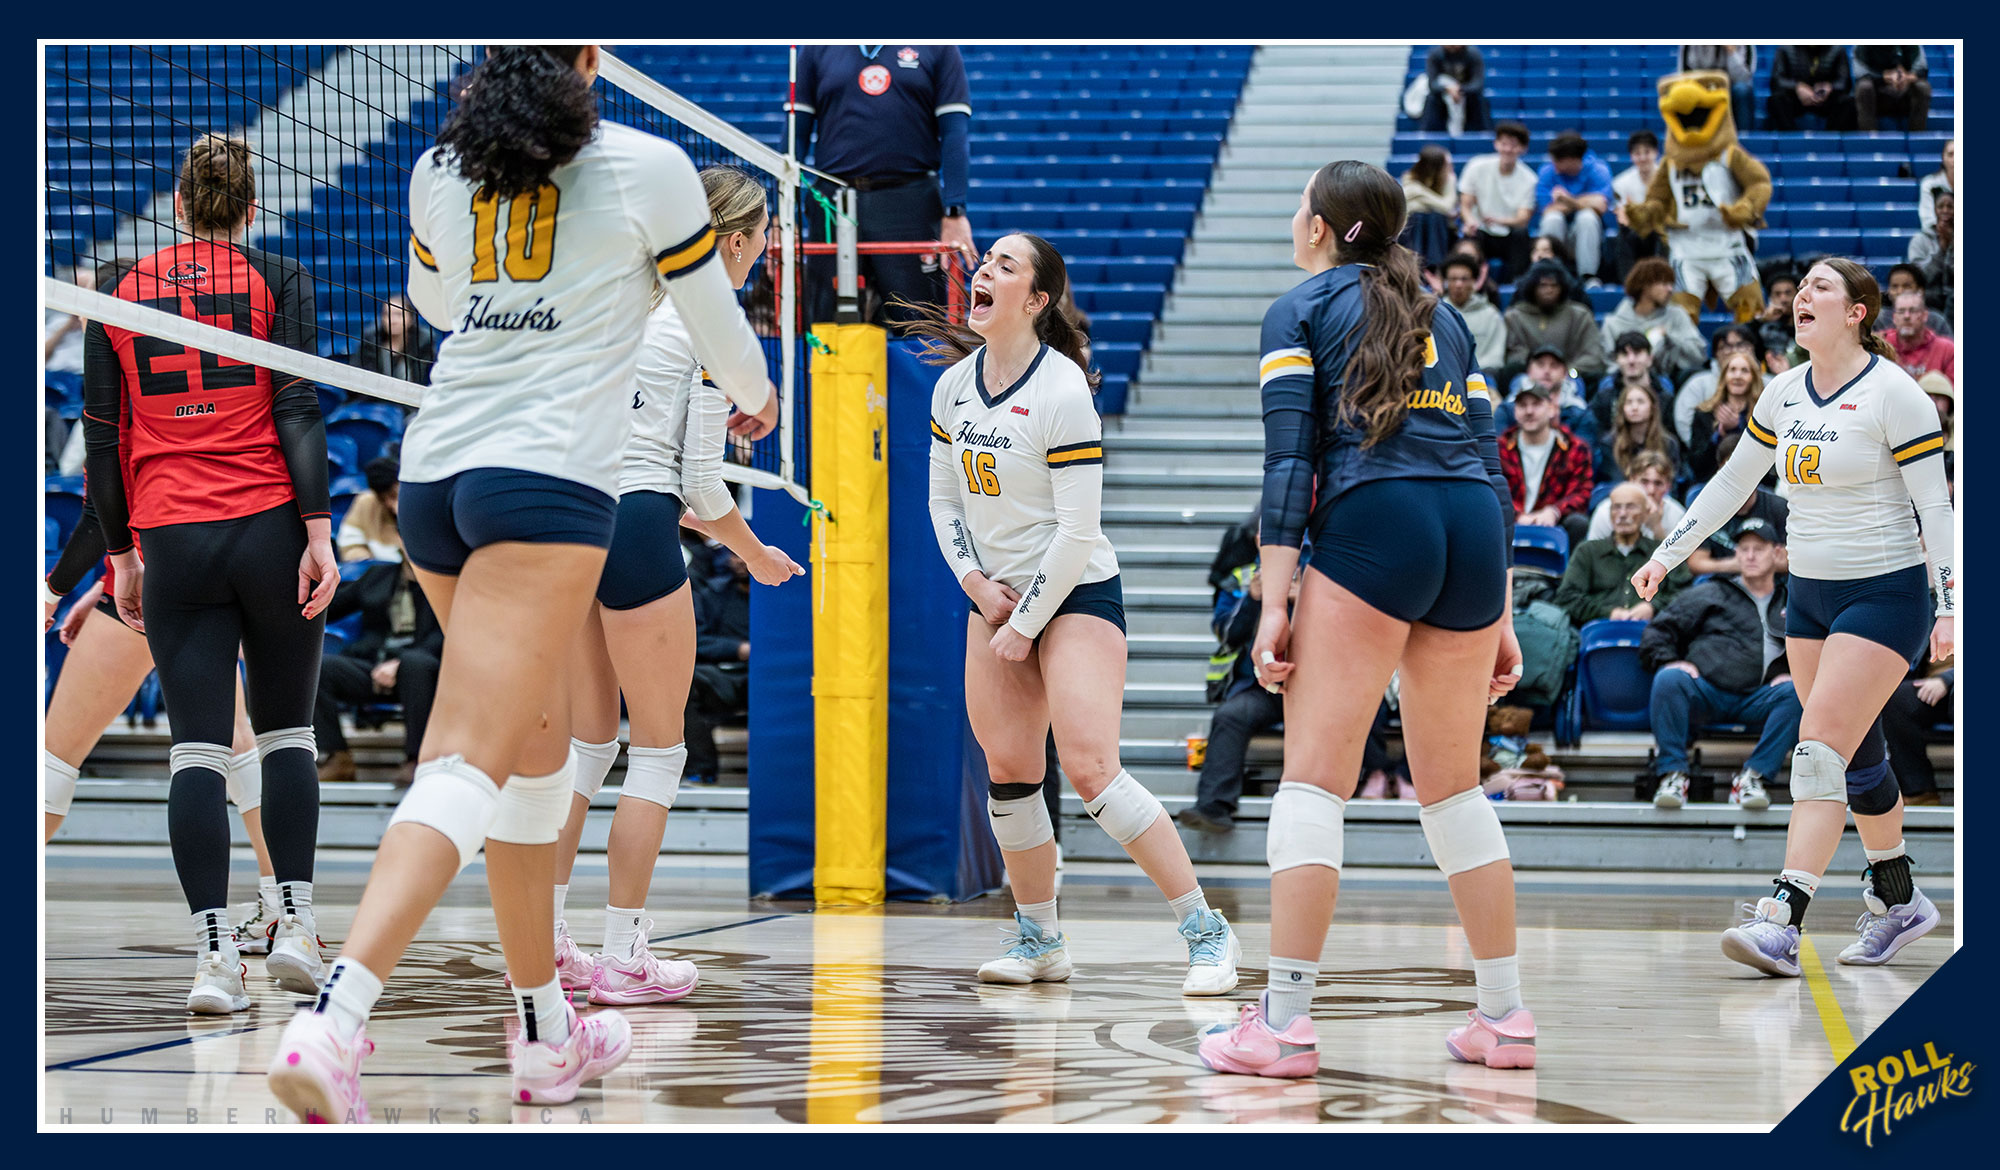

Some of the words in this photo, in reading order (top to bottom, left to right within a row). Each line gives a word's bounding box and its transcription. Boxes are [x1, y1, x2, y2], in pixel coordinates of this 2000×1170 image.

[470, 182, 560, 284] 10
[460, 295, 561, 333] Hawks
[175, 403, 216, 418] OCAA
[1406, 381, 1467, 416] awks
[956, 420, 1012, 449] Humber
[1784, 420, 1839, 442] Humber
[961, 448, 1002, 497] 16
[1785, 444, 1824, 485] 12
